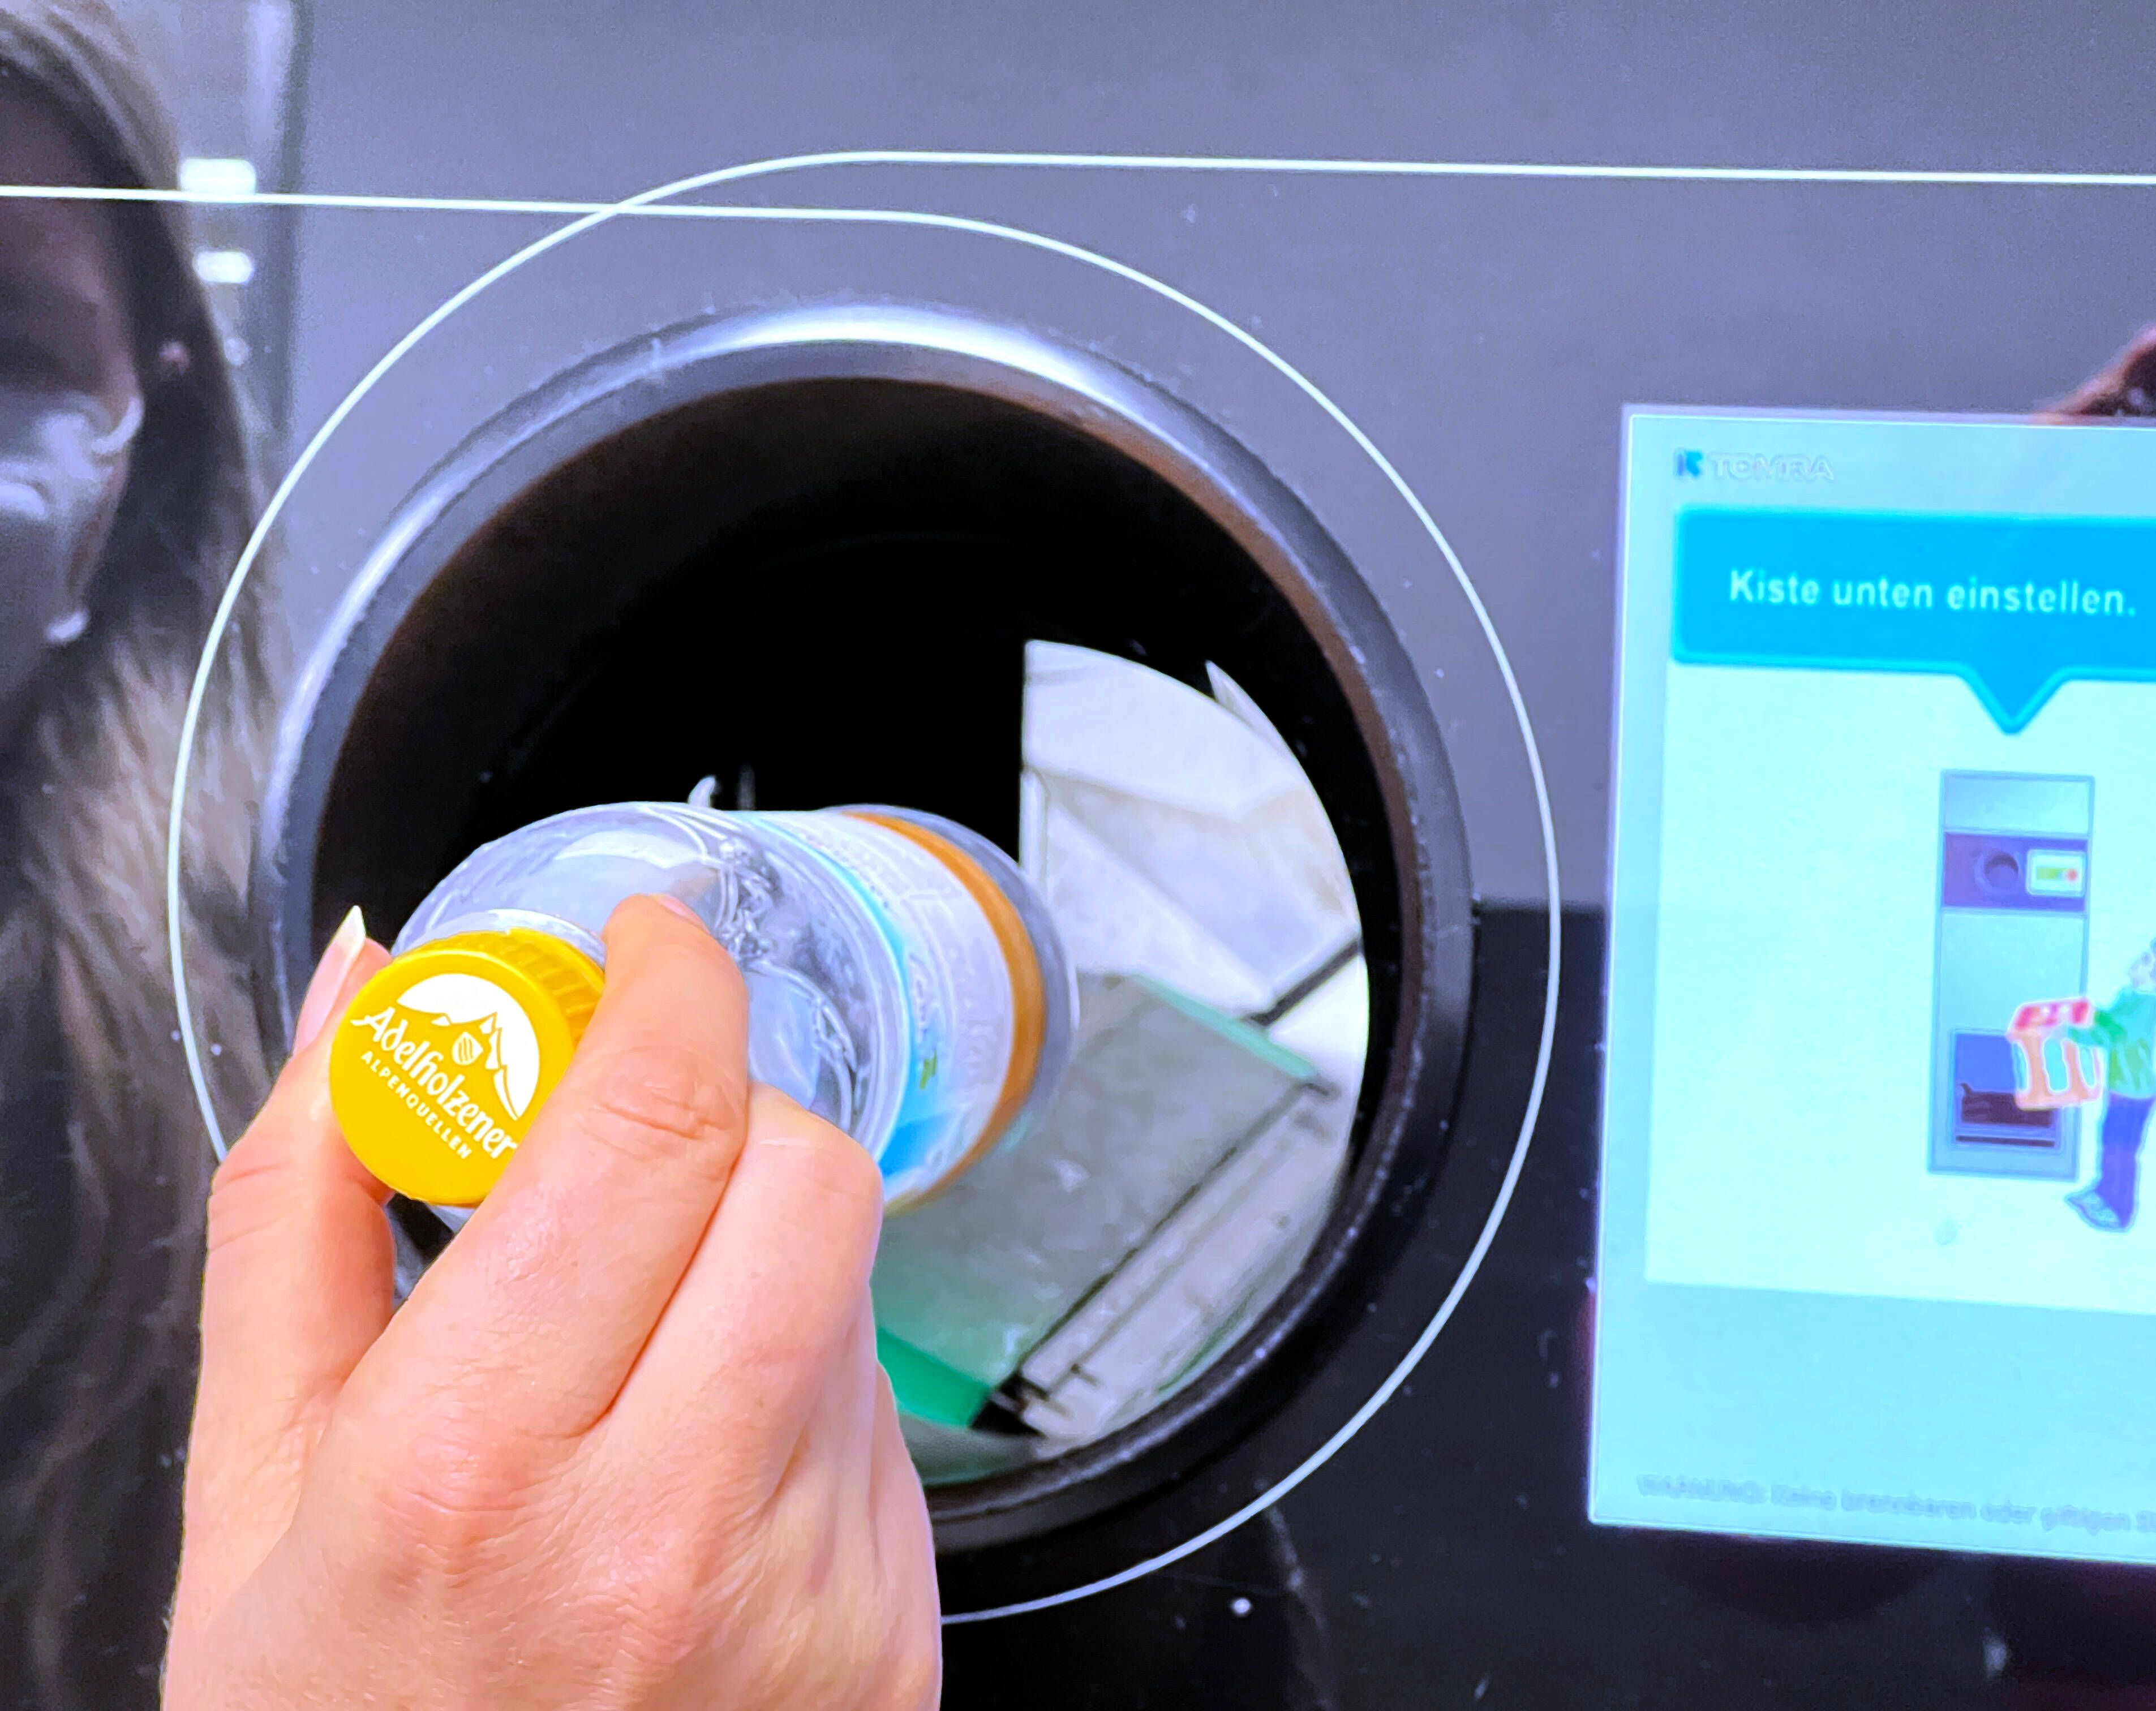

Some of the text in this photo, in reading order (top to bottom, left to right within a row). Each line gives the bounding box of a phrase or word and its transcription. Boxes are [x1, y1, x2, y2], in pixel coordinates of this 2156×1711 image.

[1707, 453, 1835, 481] TOMRA
[1730, 568, 2137, 617] Kiste unten einstellen.
[360, 1051, 472, 1159] ALPENQUELLEN
